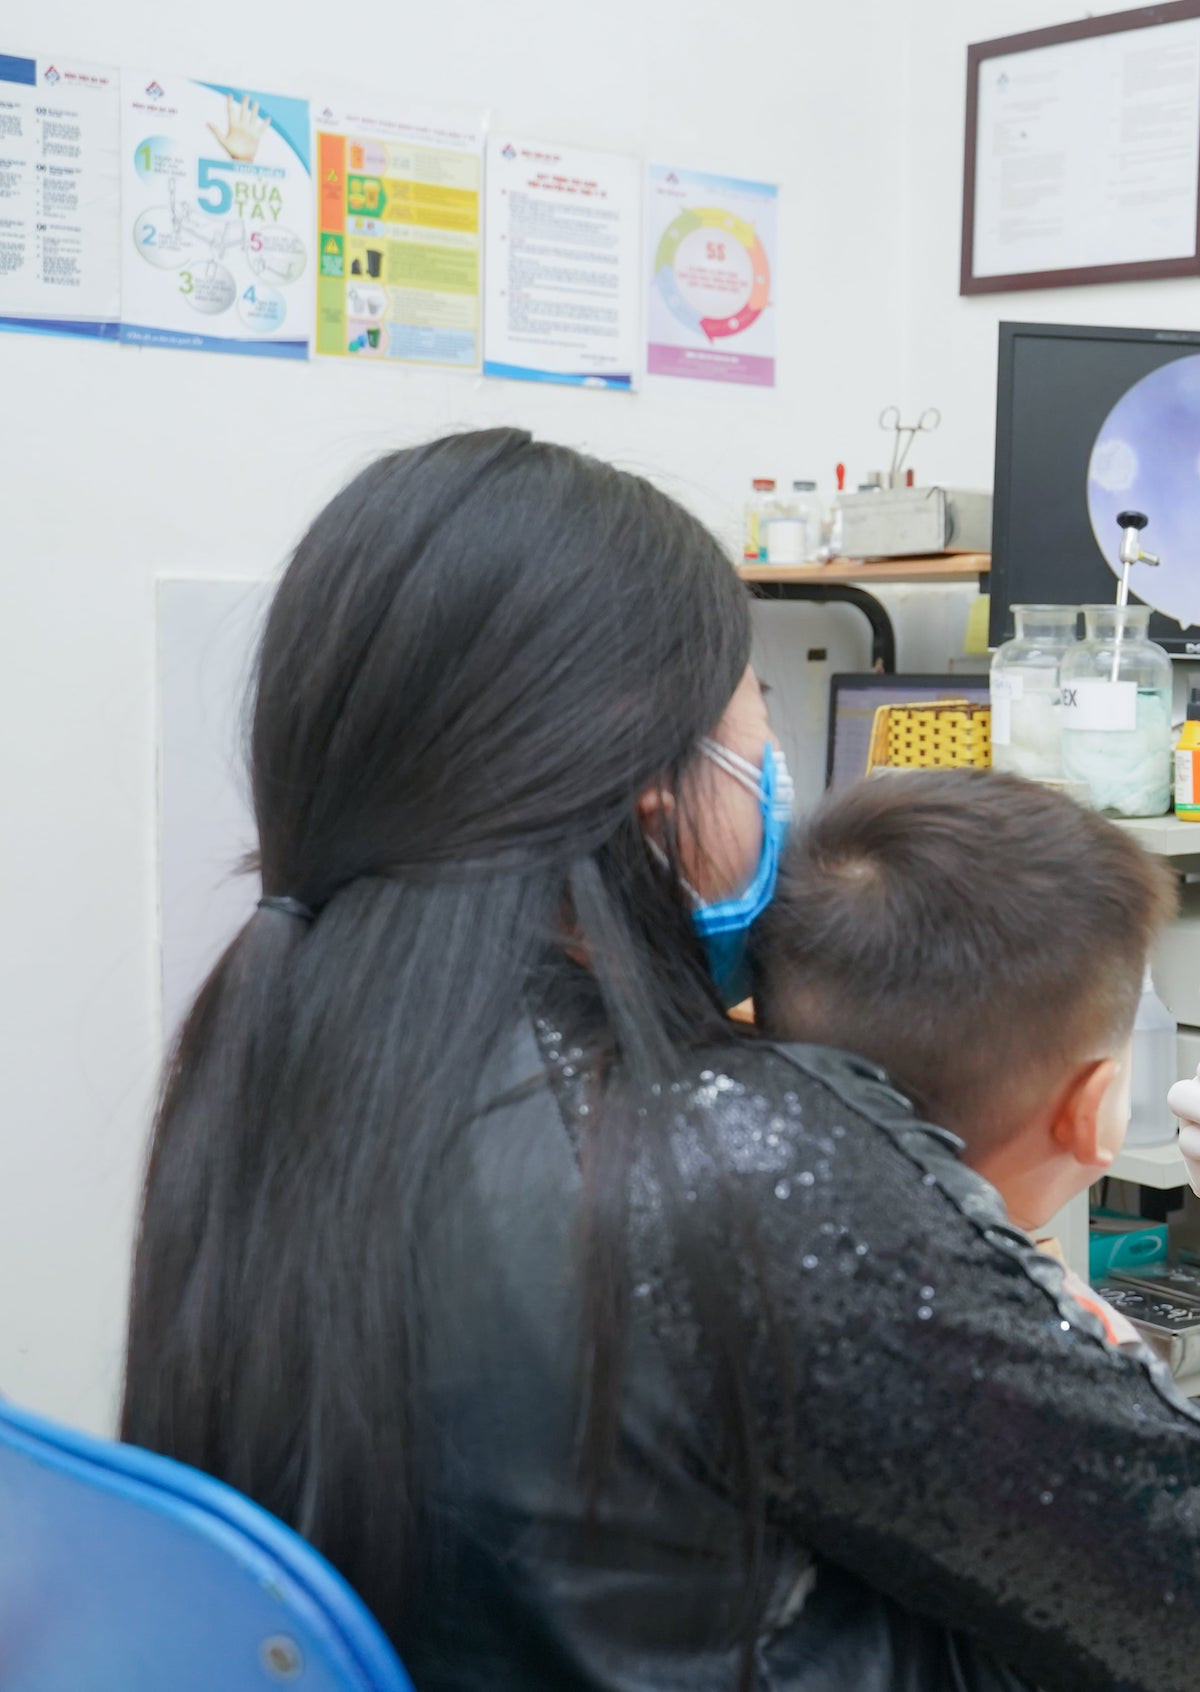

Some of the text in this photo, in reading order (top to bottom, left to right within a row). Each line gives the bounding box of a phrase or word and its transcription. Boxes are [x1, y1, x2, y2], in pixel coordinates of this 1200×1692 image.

[139, 145, 152, 172] 1
[197, 157, 234, 215] 5
[235, 201, 281, 222] TAY
[141, 224, 157, 246] 2
[250, 232, 263, 252] 5
[178, 271, 194, 294] 3
[242, 285, 257, 304] 4
